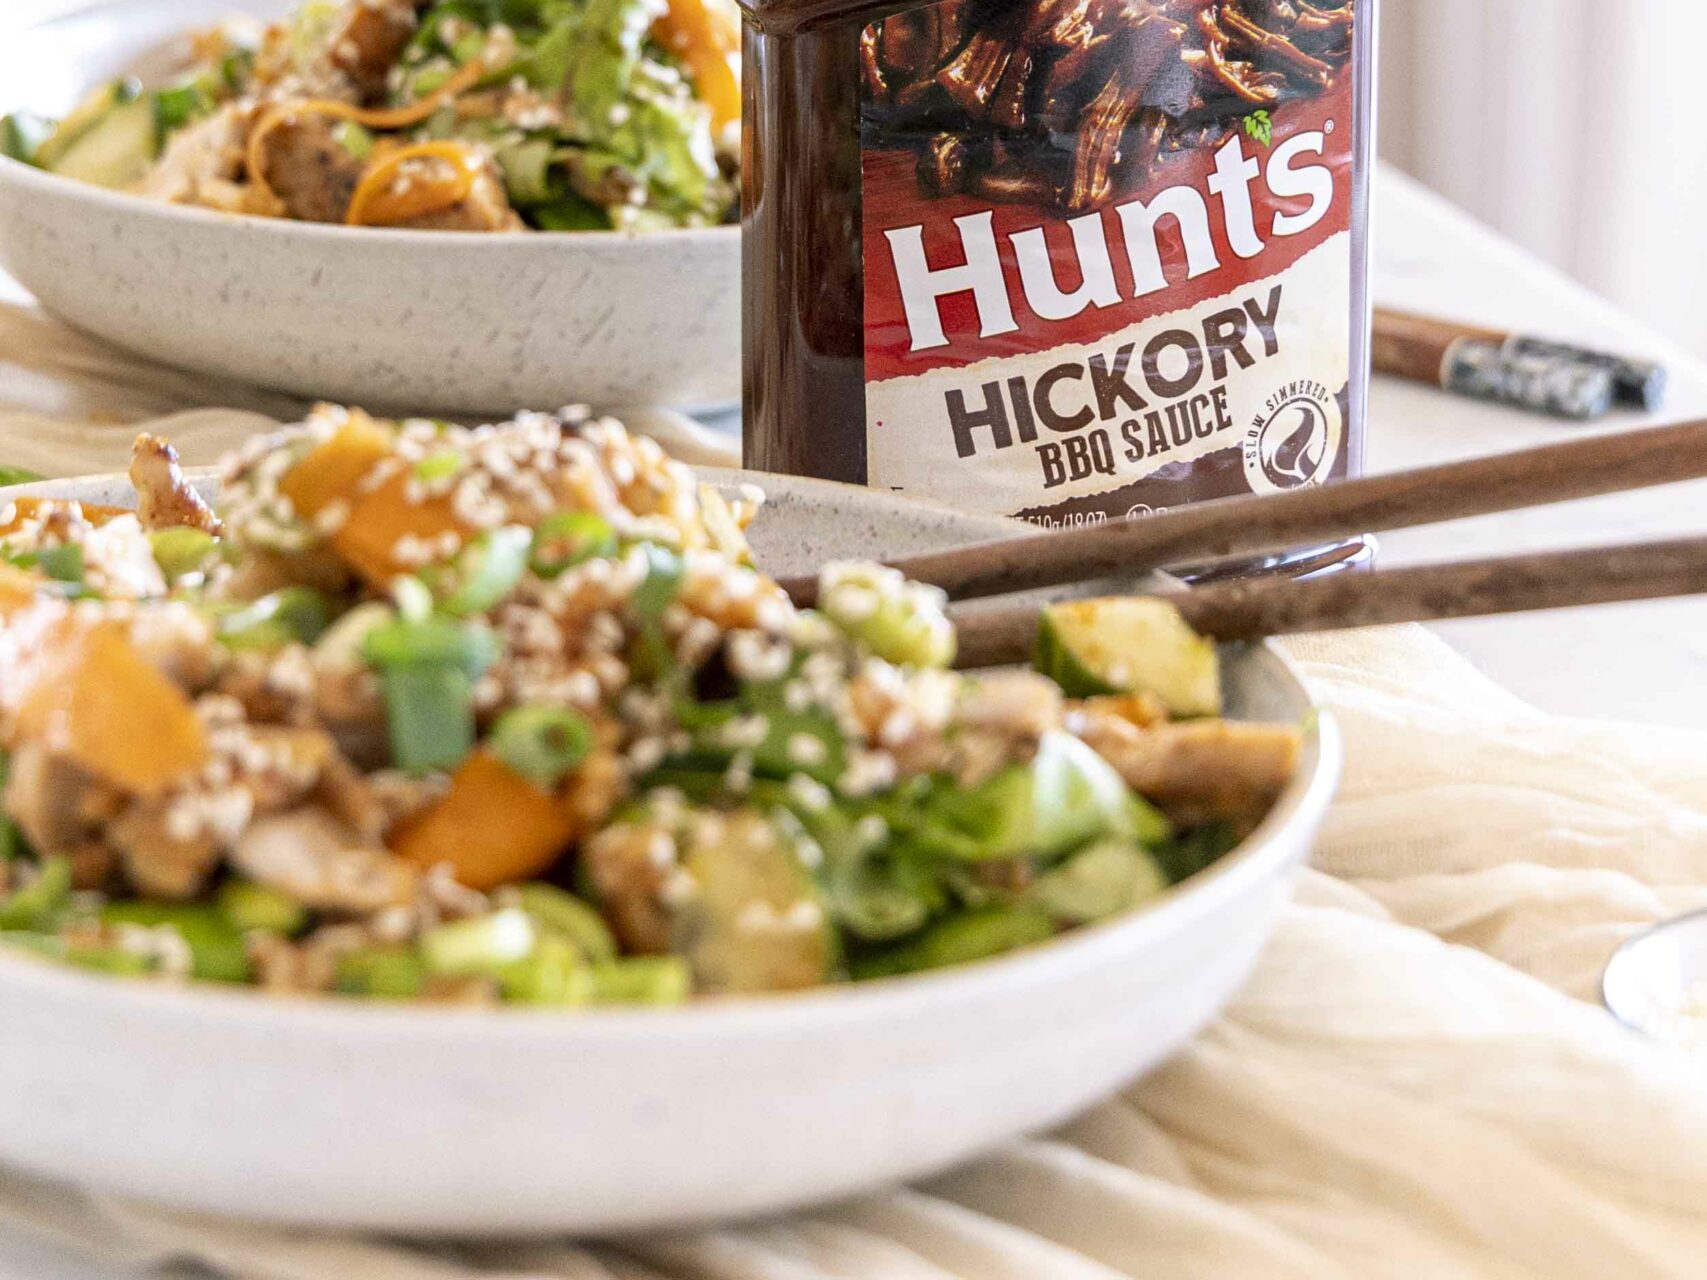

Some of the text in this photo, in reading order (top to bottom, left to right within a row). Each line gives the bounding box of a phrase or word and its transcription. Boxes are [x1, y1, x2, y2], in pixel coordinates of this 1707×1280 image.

[944, 284, 1283, 459] HICKORY
[1245, 379, 1327, 460] SLOW SIMMERED
[1035, 384, 1232, 489] BBQ SAUCE
